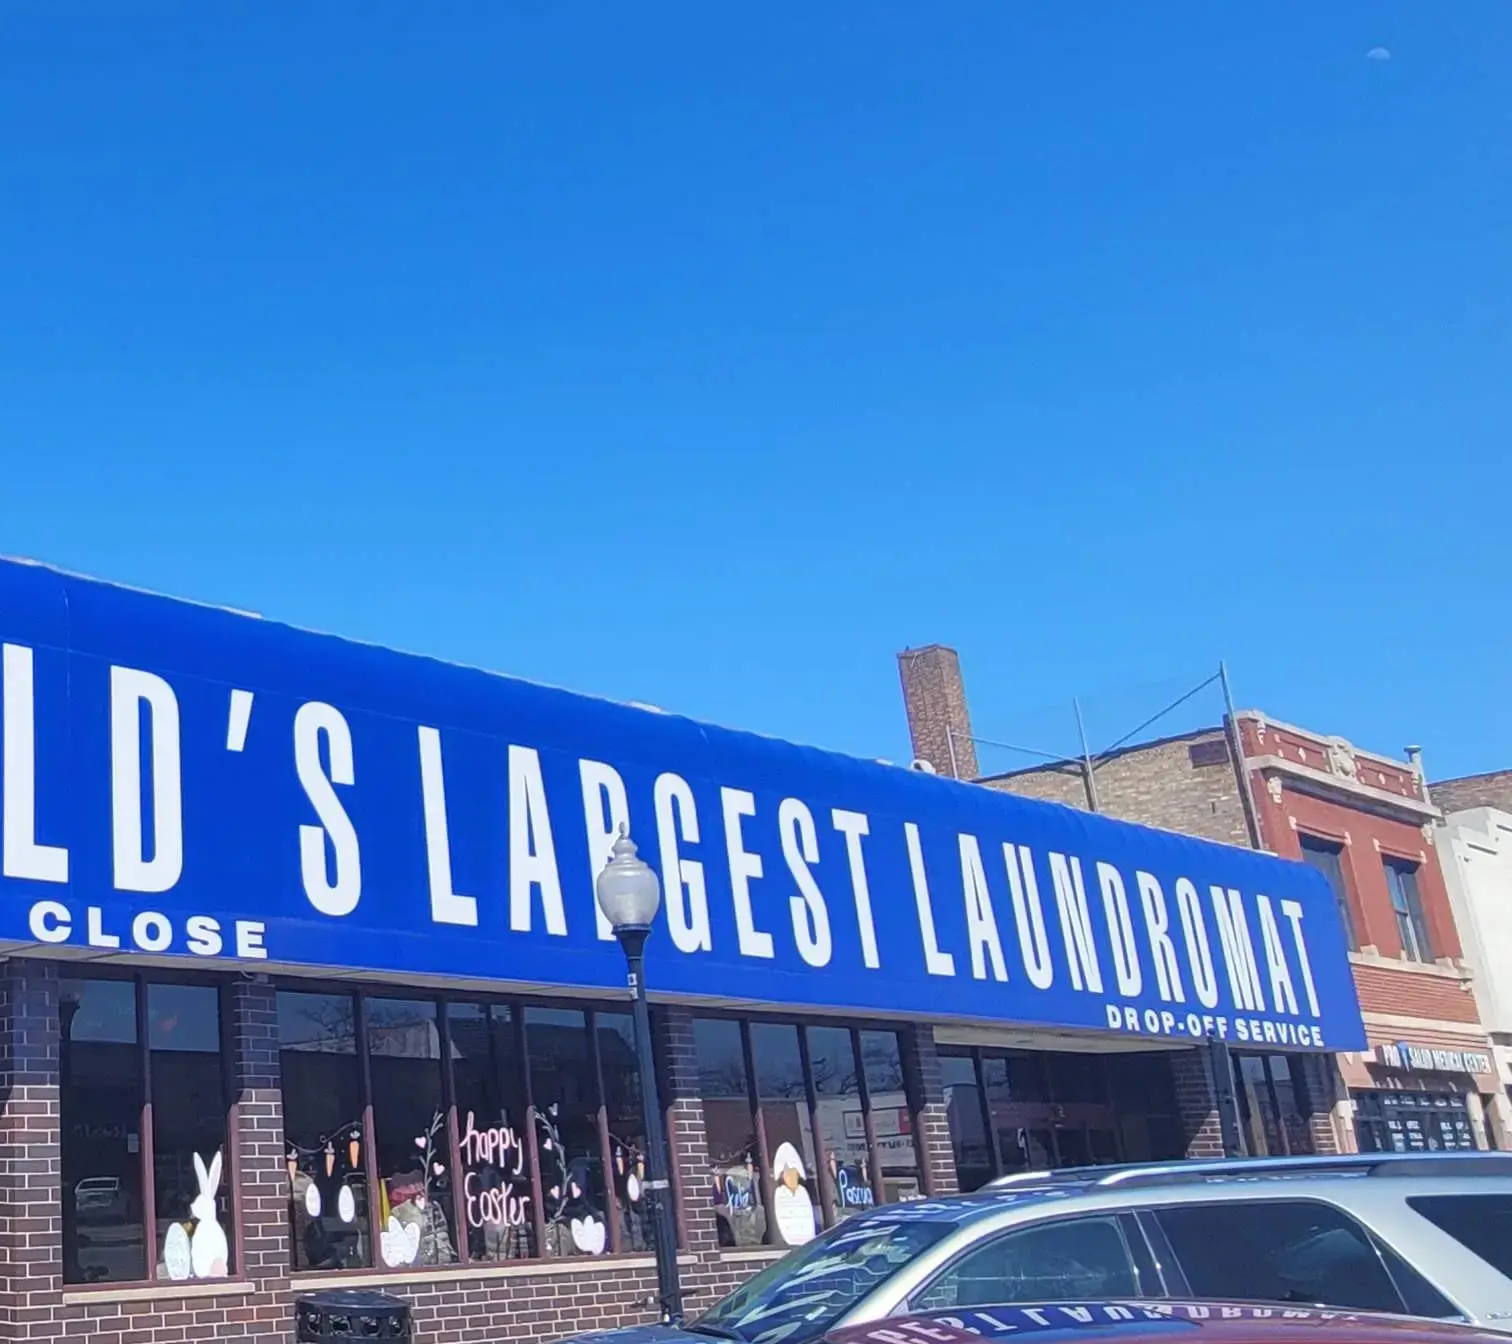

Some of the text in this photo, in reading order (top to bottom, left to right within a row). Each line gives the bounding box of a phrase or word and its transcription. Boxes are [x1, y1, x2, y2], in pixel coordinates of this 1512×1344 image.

[29, 900, 268, 959] CLOSE
[904, 822, 1321, 1017] LAUNDROMAT
[1106, 1004, 1324, 1047] DROP-OFF SERVICE
[464, 1171, 530, 1227] Easter
